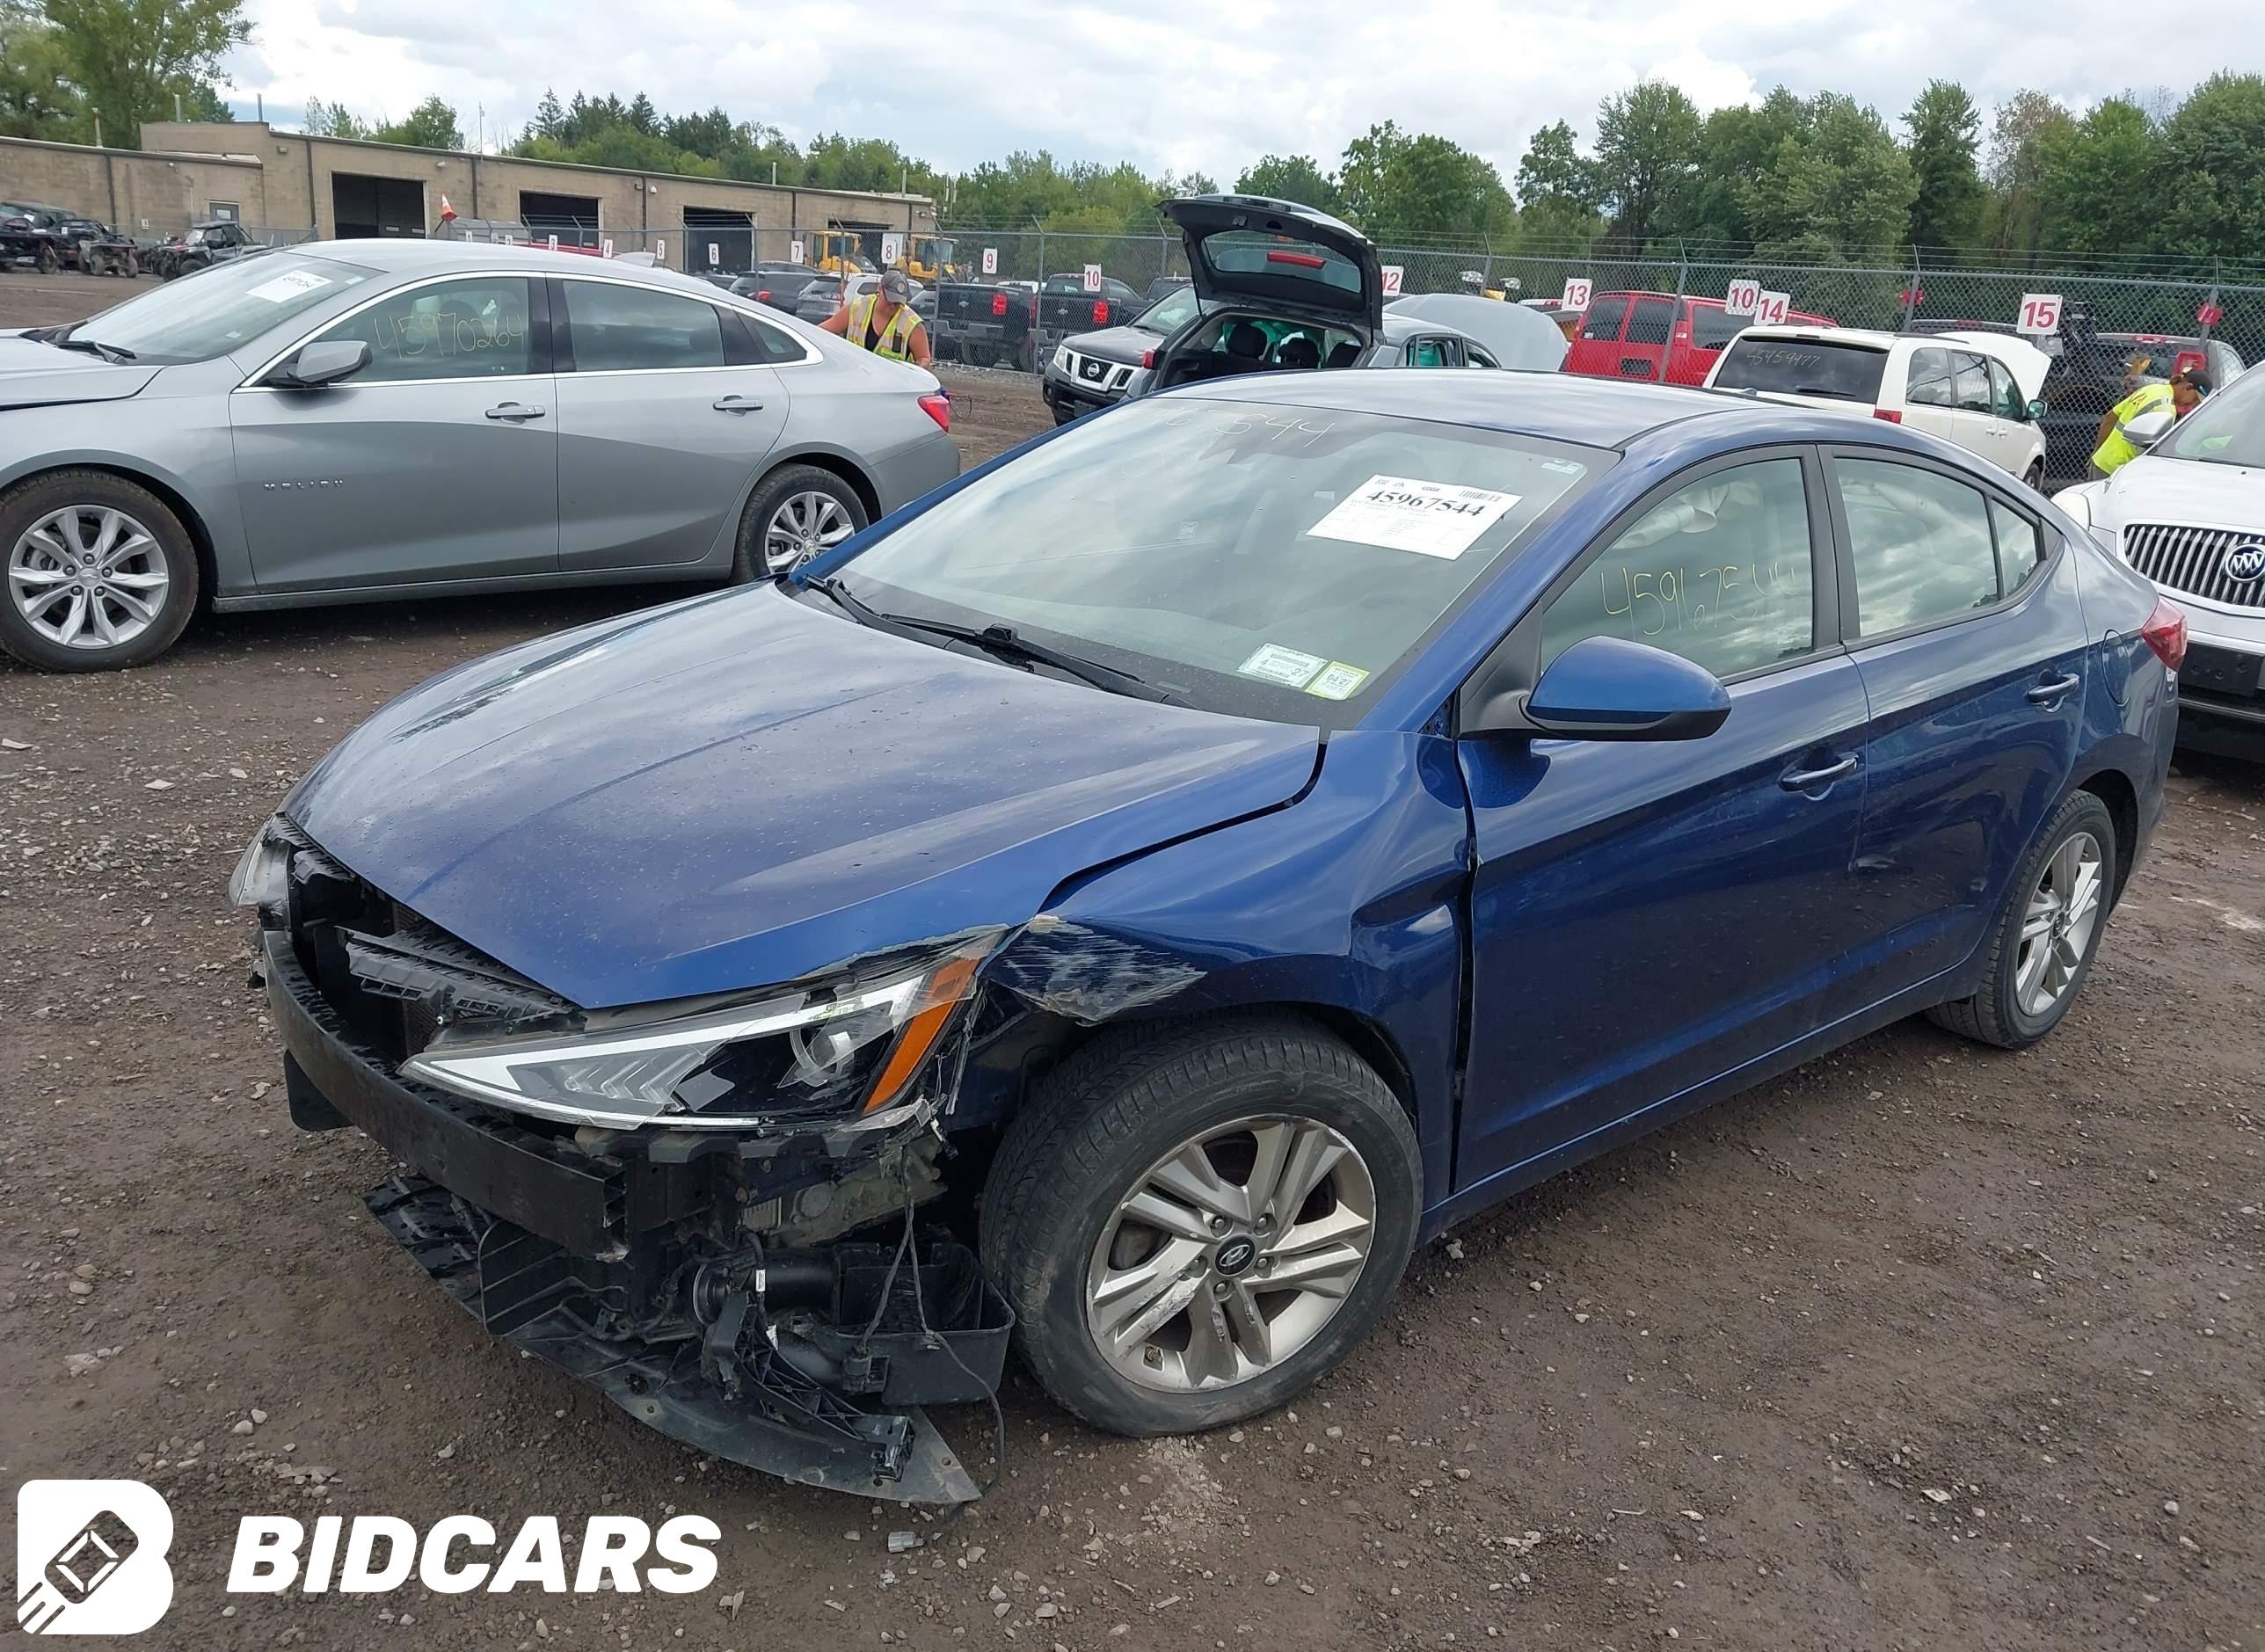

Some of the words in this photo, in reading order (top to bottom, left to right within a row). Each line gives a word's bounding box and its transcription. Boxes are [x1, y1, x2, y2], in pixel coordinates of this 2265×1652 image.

[659, 243, 664, 257] 5
[711, 247, 717, 261] 6
[794, 244, 800, 259] 7
[885, 244, 892, 260] 8
[987, 252, 994, 269] 9
[1086, 270, 1100, 287] 10
[1567, 284, 1588, 306] 13
[1731, 287, 1755, 309] 10
[1760, 298, 1784, 323] 14
[2023, 300, 2057, 329] 15
[374, 312, 524, 360] 45970264
[1366, 490, 1486, 517] 45967544
